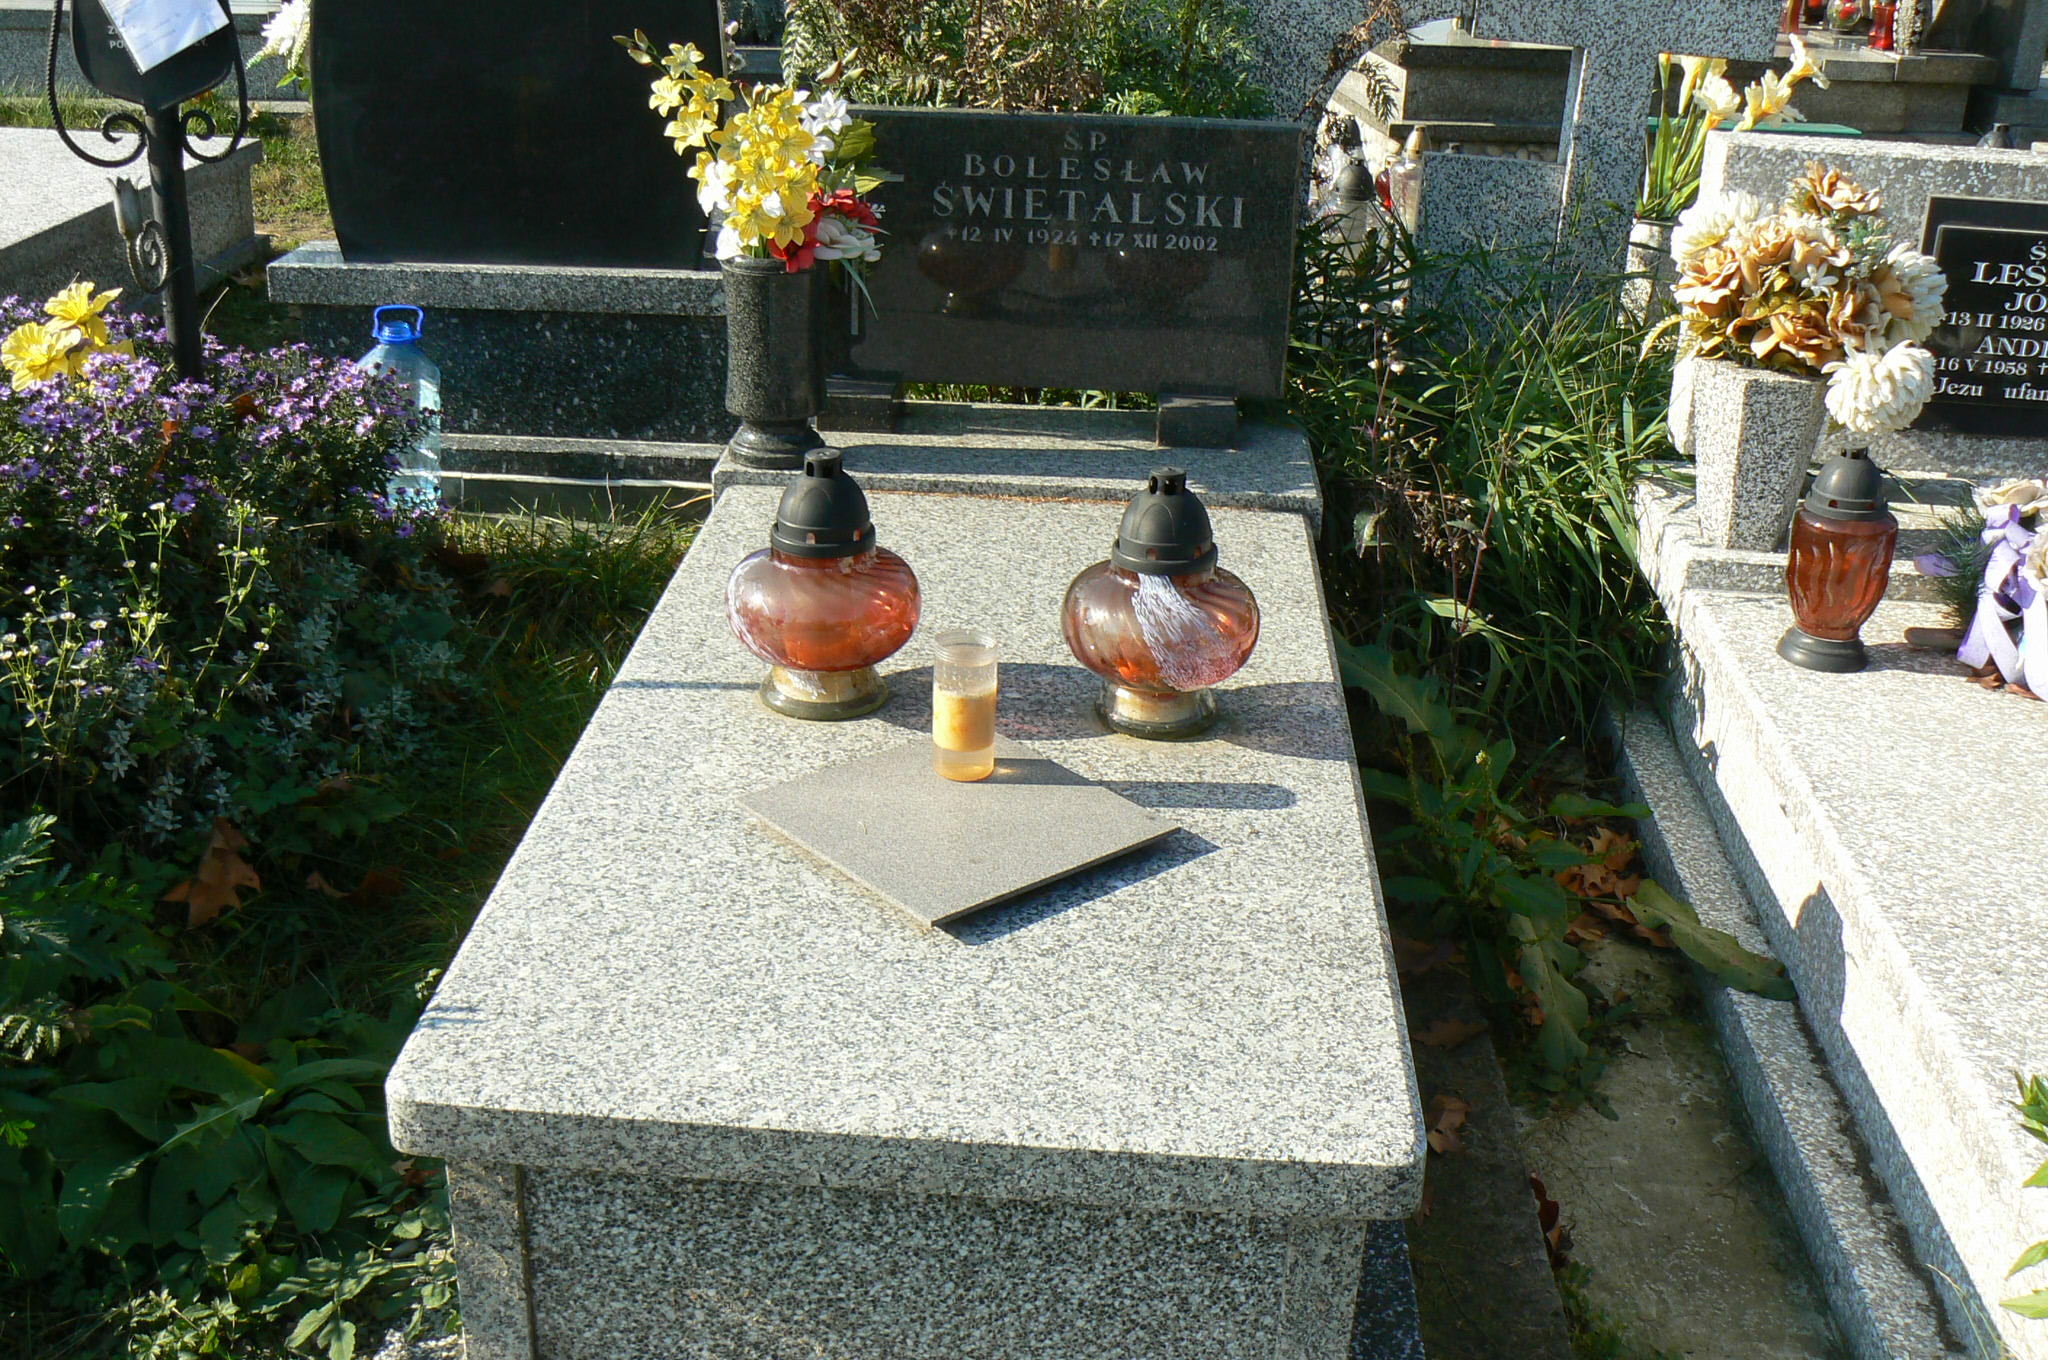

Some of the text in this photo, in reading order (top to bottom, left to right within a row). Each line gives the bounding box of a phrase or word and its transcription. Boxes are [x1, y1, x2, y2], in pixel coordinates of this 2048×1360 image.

[963, 153, 1209, 185] BOLESŁAW
[994, 228, 1014, 242] IV
[1027, 229, 1078, 246] 1924
[1133, 233, 1158, 249] XII
[1164, 234, 1218, 252] 2002
[1970, 260, 2048, 287] LEŚ
[2003, 288, 2048, 313] JÓ
[1948, 311, 2046, 332] 13 II 1926
[1937, 356, 2028, 376] 16 V 1958
[1934, 376, 1984, 397] Jezu
